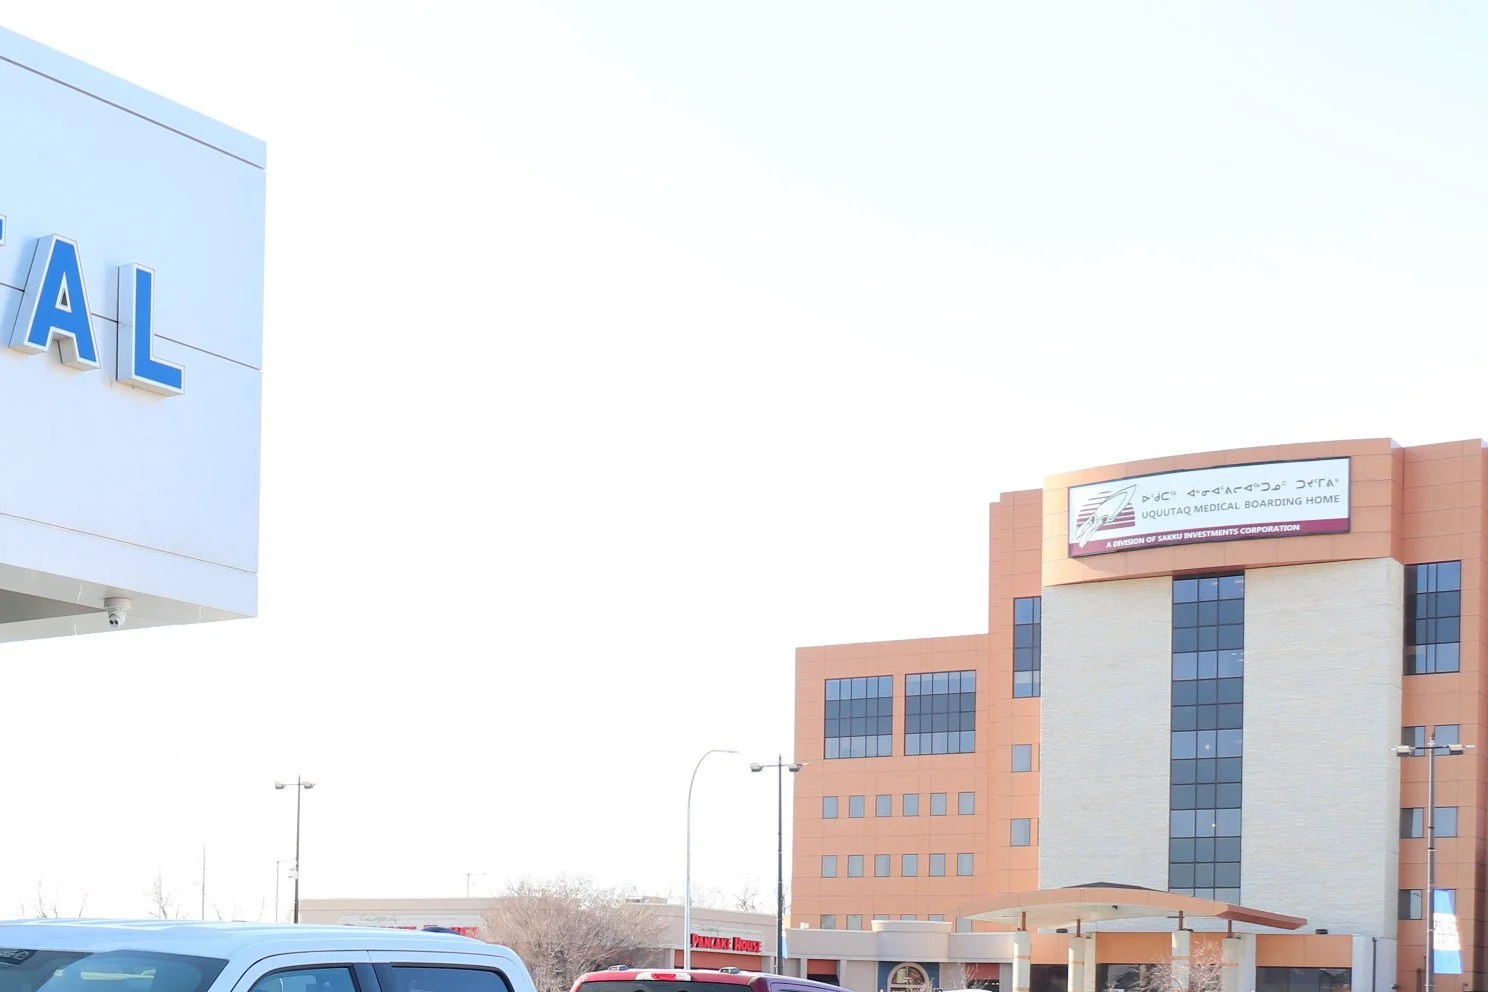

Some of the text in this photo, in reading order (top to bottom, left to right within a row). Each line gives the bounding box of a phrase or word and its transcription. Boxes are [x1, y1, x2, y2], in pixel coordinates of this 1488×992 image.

[1142, 494, 1340, 519] UQUUTAQ MEDICAL BOARDING HOME
[1112, 537, 1145, 548] DIVISION
[1157, 533, 1182, 542] SAKKU
[1183, 527, 1239, 539] INVESTMENTS
[1239, 524, 1300, 535] CORPORATION
[733, 936, 762, 953] HOUSE
